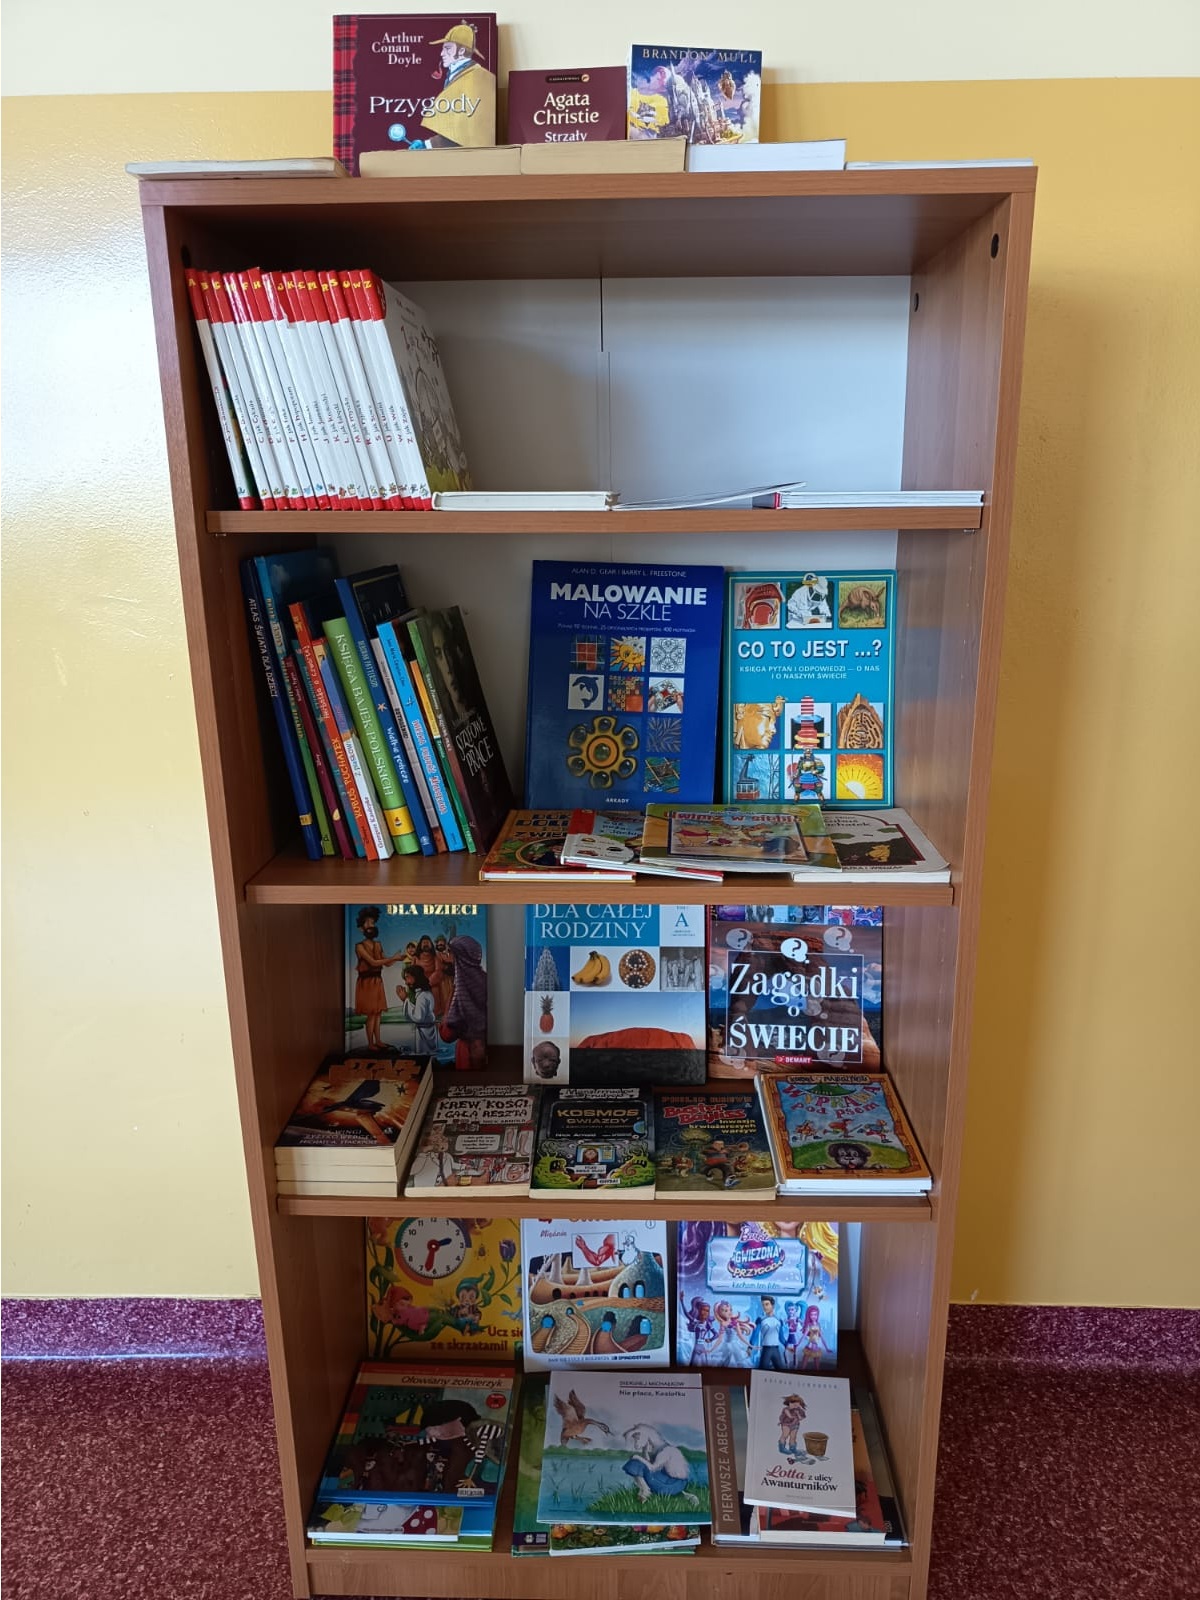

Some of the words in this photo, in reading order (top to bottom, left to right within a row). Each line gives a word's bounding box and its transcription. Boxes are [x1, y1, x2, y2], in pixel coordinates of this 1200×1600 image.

[382, 32, 424, 43] Arthur
[371, 42, 409, 53] Conan
[642, 48, 708, 60] BRANDON
[718, 52, 757, 64] MULL
[388, 53, 422, 67] Doyle
[369, 93, 481, 117] Przygody
[544, 92, 590, 110] Agata
[533, 108, 599, 125] Christie
[550, 582, 707, 605] MALOWANIE
[247, 597, 262, 623] ATLAS
[583, 602, 612, 619] NA
[617, 603, 672, 621] SZKLE
[253, 623, 270, 654] ŚWIATA
[738, 641, 764, 658] CO
[770, 640, 796, 658] TO
[802, 640, 848, 658] JEST
[261, 655, 272, 671] DLA
[739, 665, 766, 673] KSIĘGA
[768, 664, 793, 672] PYTAŃ
[265, 671, 278, 698] DZIECI
[333, 633, 359, 685] KSIĘGA
[352, 686, 372, 729] BAJEK
[366, 730, 394, 796] POLSKICH
[331, 736, 352, 785] PUCHATEK
[466, 736, 494, 776] PRACE
[347, 787, 363, 820] KUBUŚ
[386, 904, 418, 915] DLA
[423, 904, 478, 915] DZIECI
[534, 904, 580, 919] DLA
[585, 904, 652, 919] CAŁEJ
[674, 912, 690, 928] A
[540, 922, 647, 939] RODZINY
[730, 963, 859, 1005] Zagadki
[787, 1005, 800, 1017] o
[729, 1015, 859, 1053] ŚWIECIE
[557, 1109, 639, 1117] KOSMOS
[735, 1245, 779, 1263] GWIEZDNA
[733, 1261, 783, 1277] PRZYGODA
[488, 1327, 508, 1336] Ucz
[402, 1375, 450, 1386] Ołowiany
[452, 1377, 503, 1388] żołnierzyk
[714, 1392, 729, 1454] ABECADŁO
[766, 1465, 805, 1479] Lotta
[814, 1474, 832, 1483] ulicy
[718, 1458, 735, 1522] PIERWSZE
[761, 1477, 838, 1491] Awanturników
